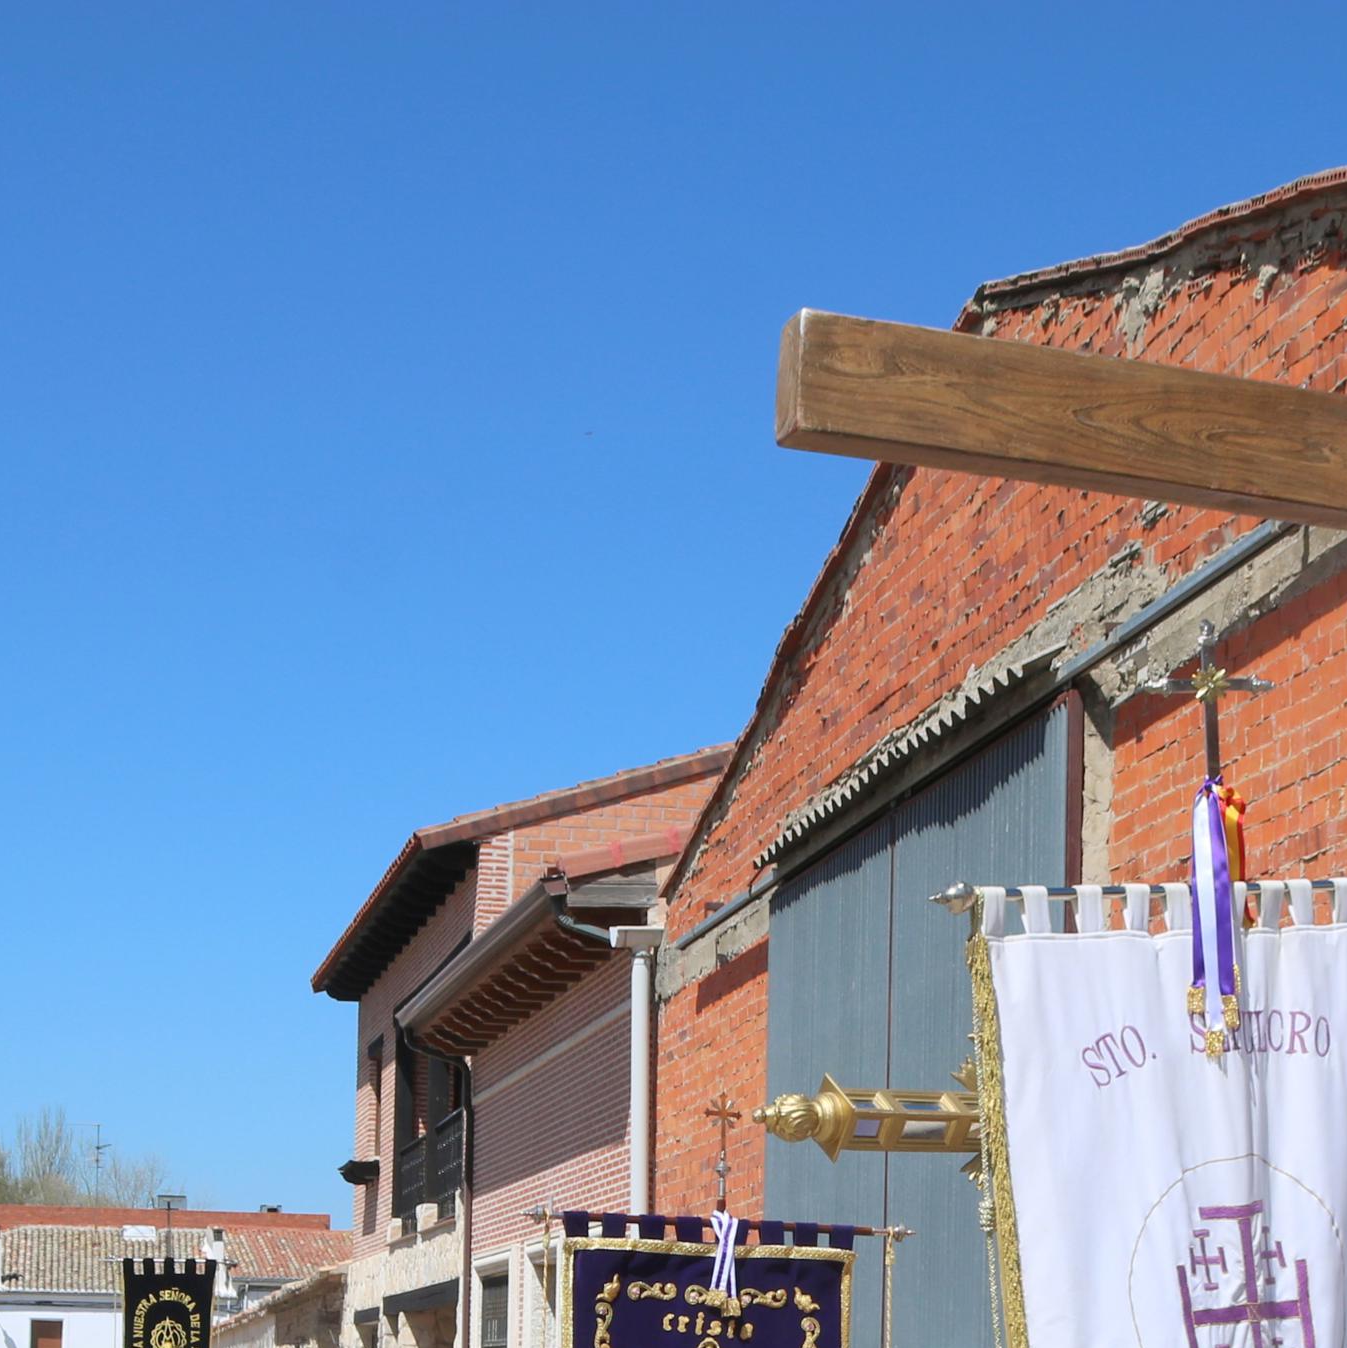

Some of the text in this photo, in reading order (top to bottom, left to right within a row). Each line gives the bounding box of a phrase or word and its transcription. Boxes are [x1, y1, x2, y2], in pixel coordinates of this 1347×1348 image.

[1082, 1024, 1157, 1090] STO.
[159, 1287, 197, 1313] SEÑORA
[133, 1293, 158, 1338] NUESTRA
[189, 1313, 201, 1328] DE
[190, 1330, 201, 1344] LA
